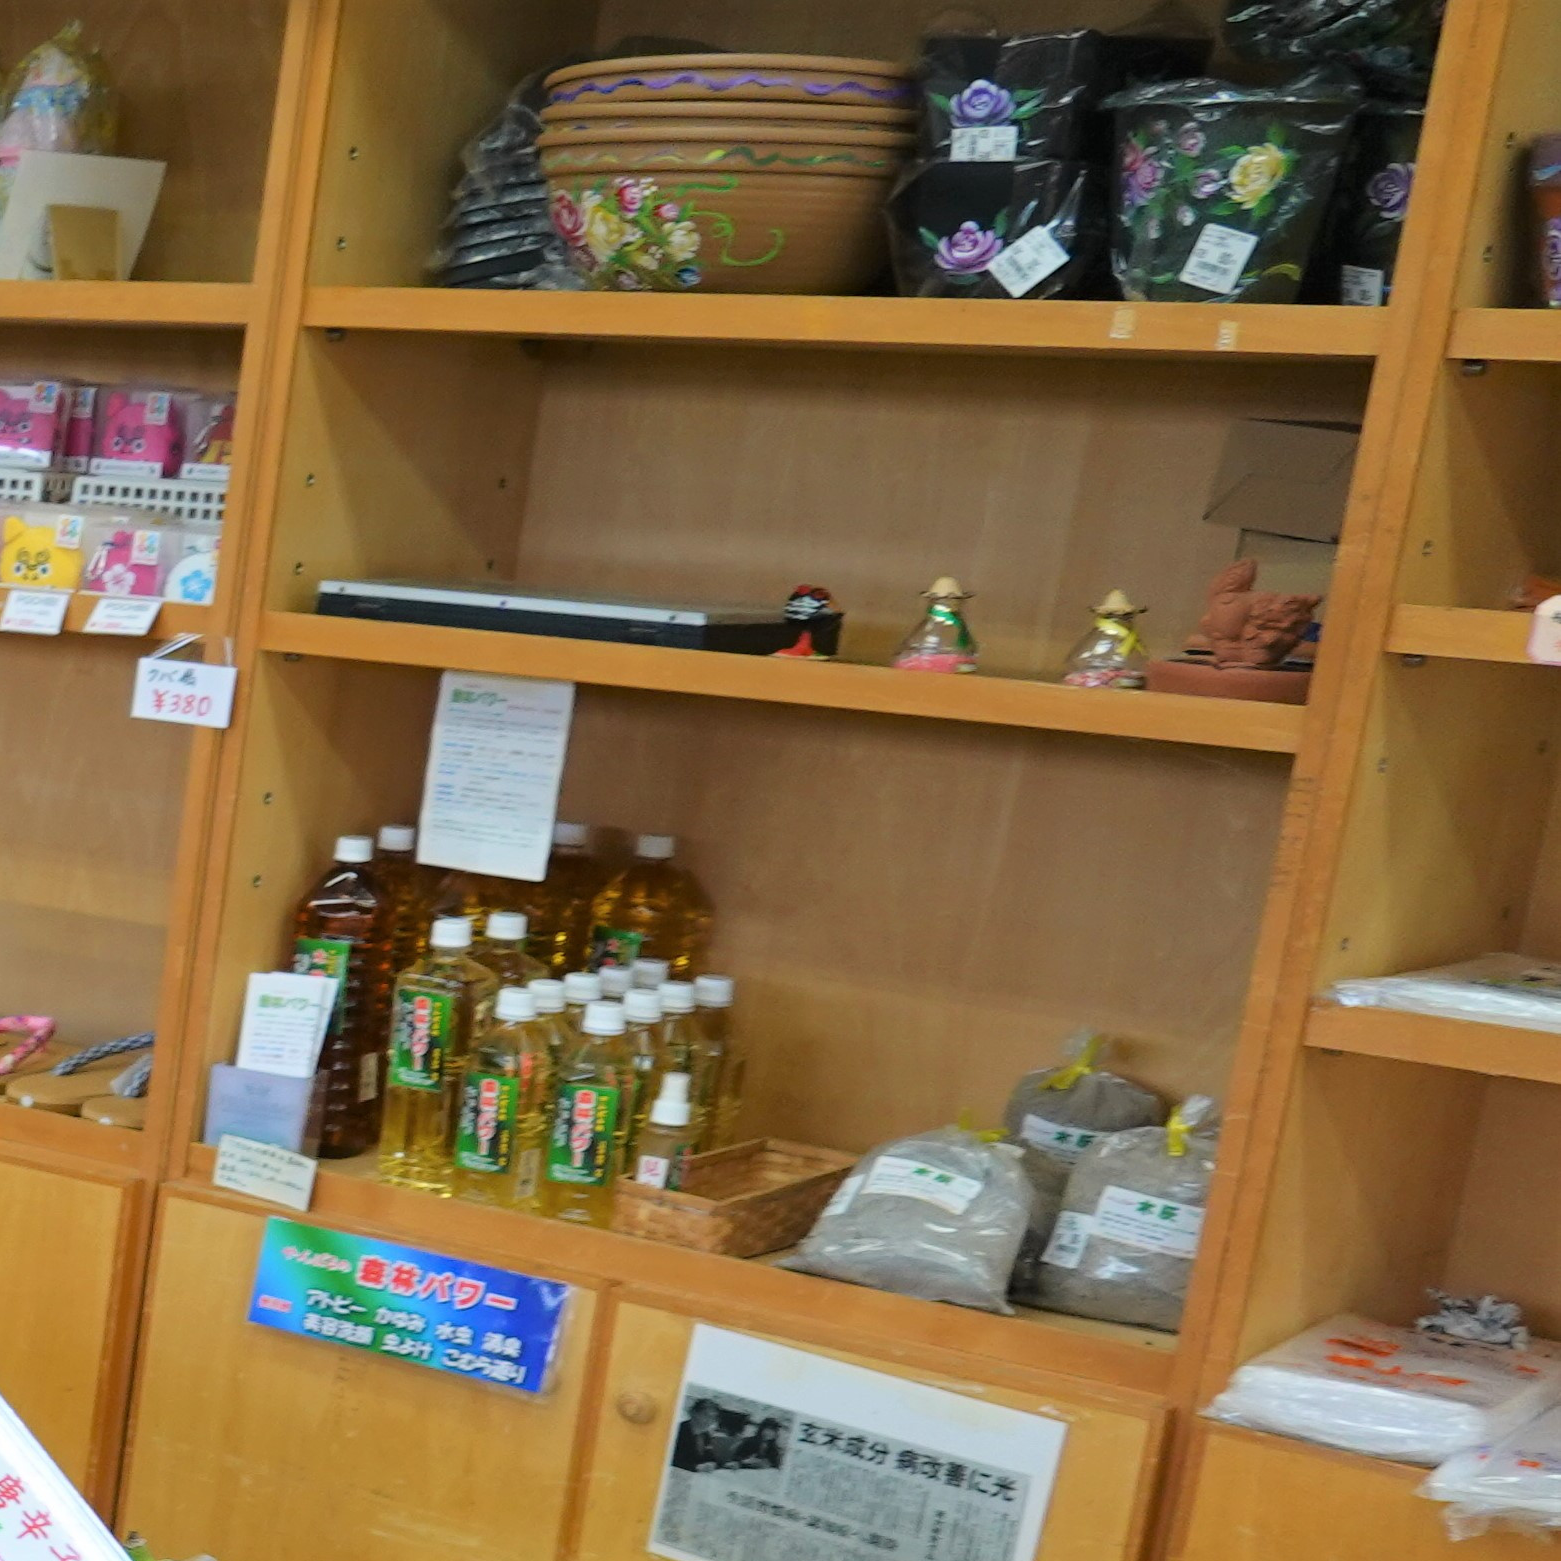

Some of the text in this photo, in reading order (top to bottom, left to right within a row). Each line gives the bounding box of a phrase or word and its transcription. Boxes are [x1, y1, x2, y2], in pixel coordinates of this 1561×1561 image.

[151, 690, 212, 718] ¥380
[304, 1287, 368, 1320] アトピー
[373, 1304, 427, 1334] かゆみ
[796, 1421, 1018, 1503] 玄米成分 病改善に光
